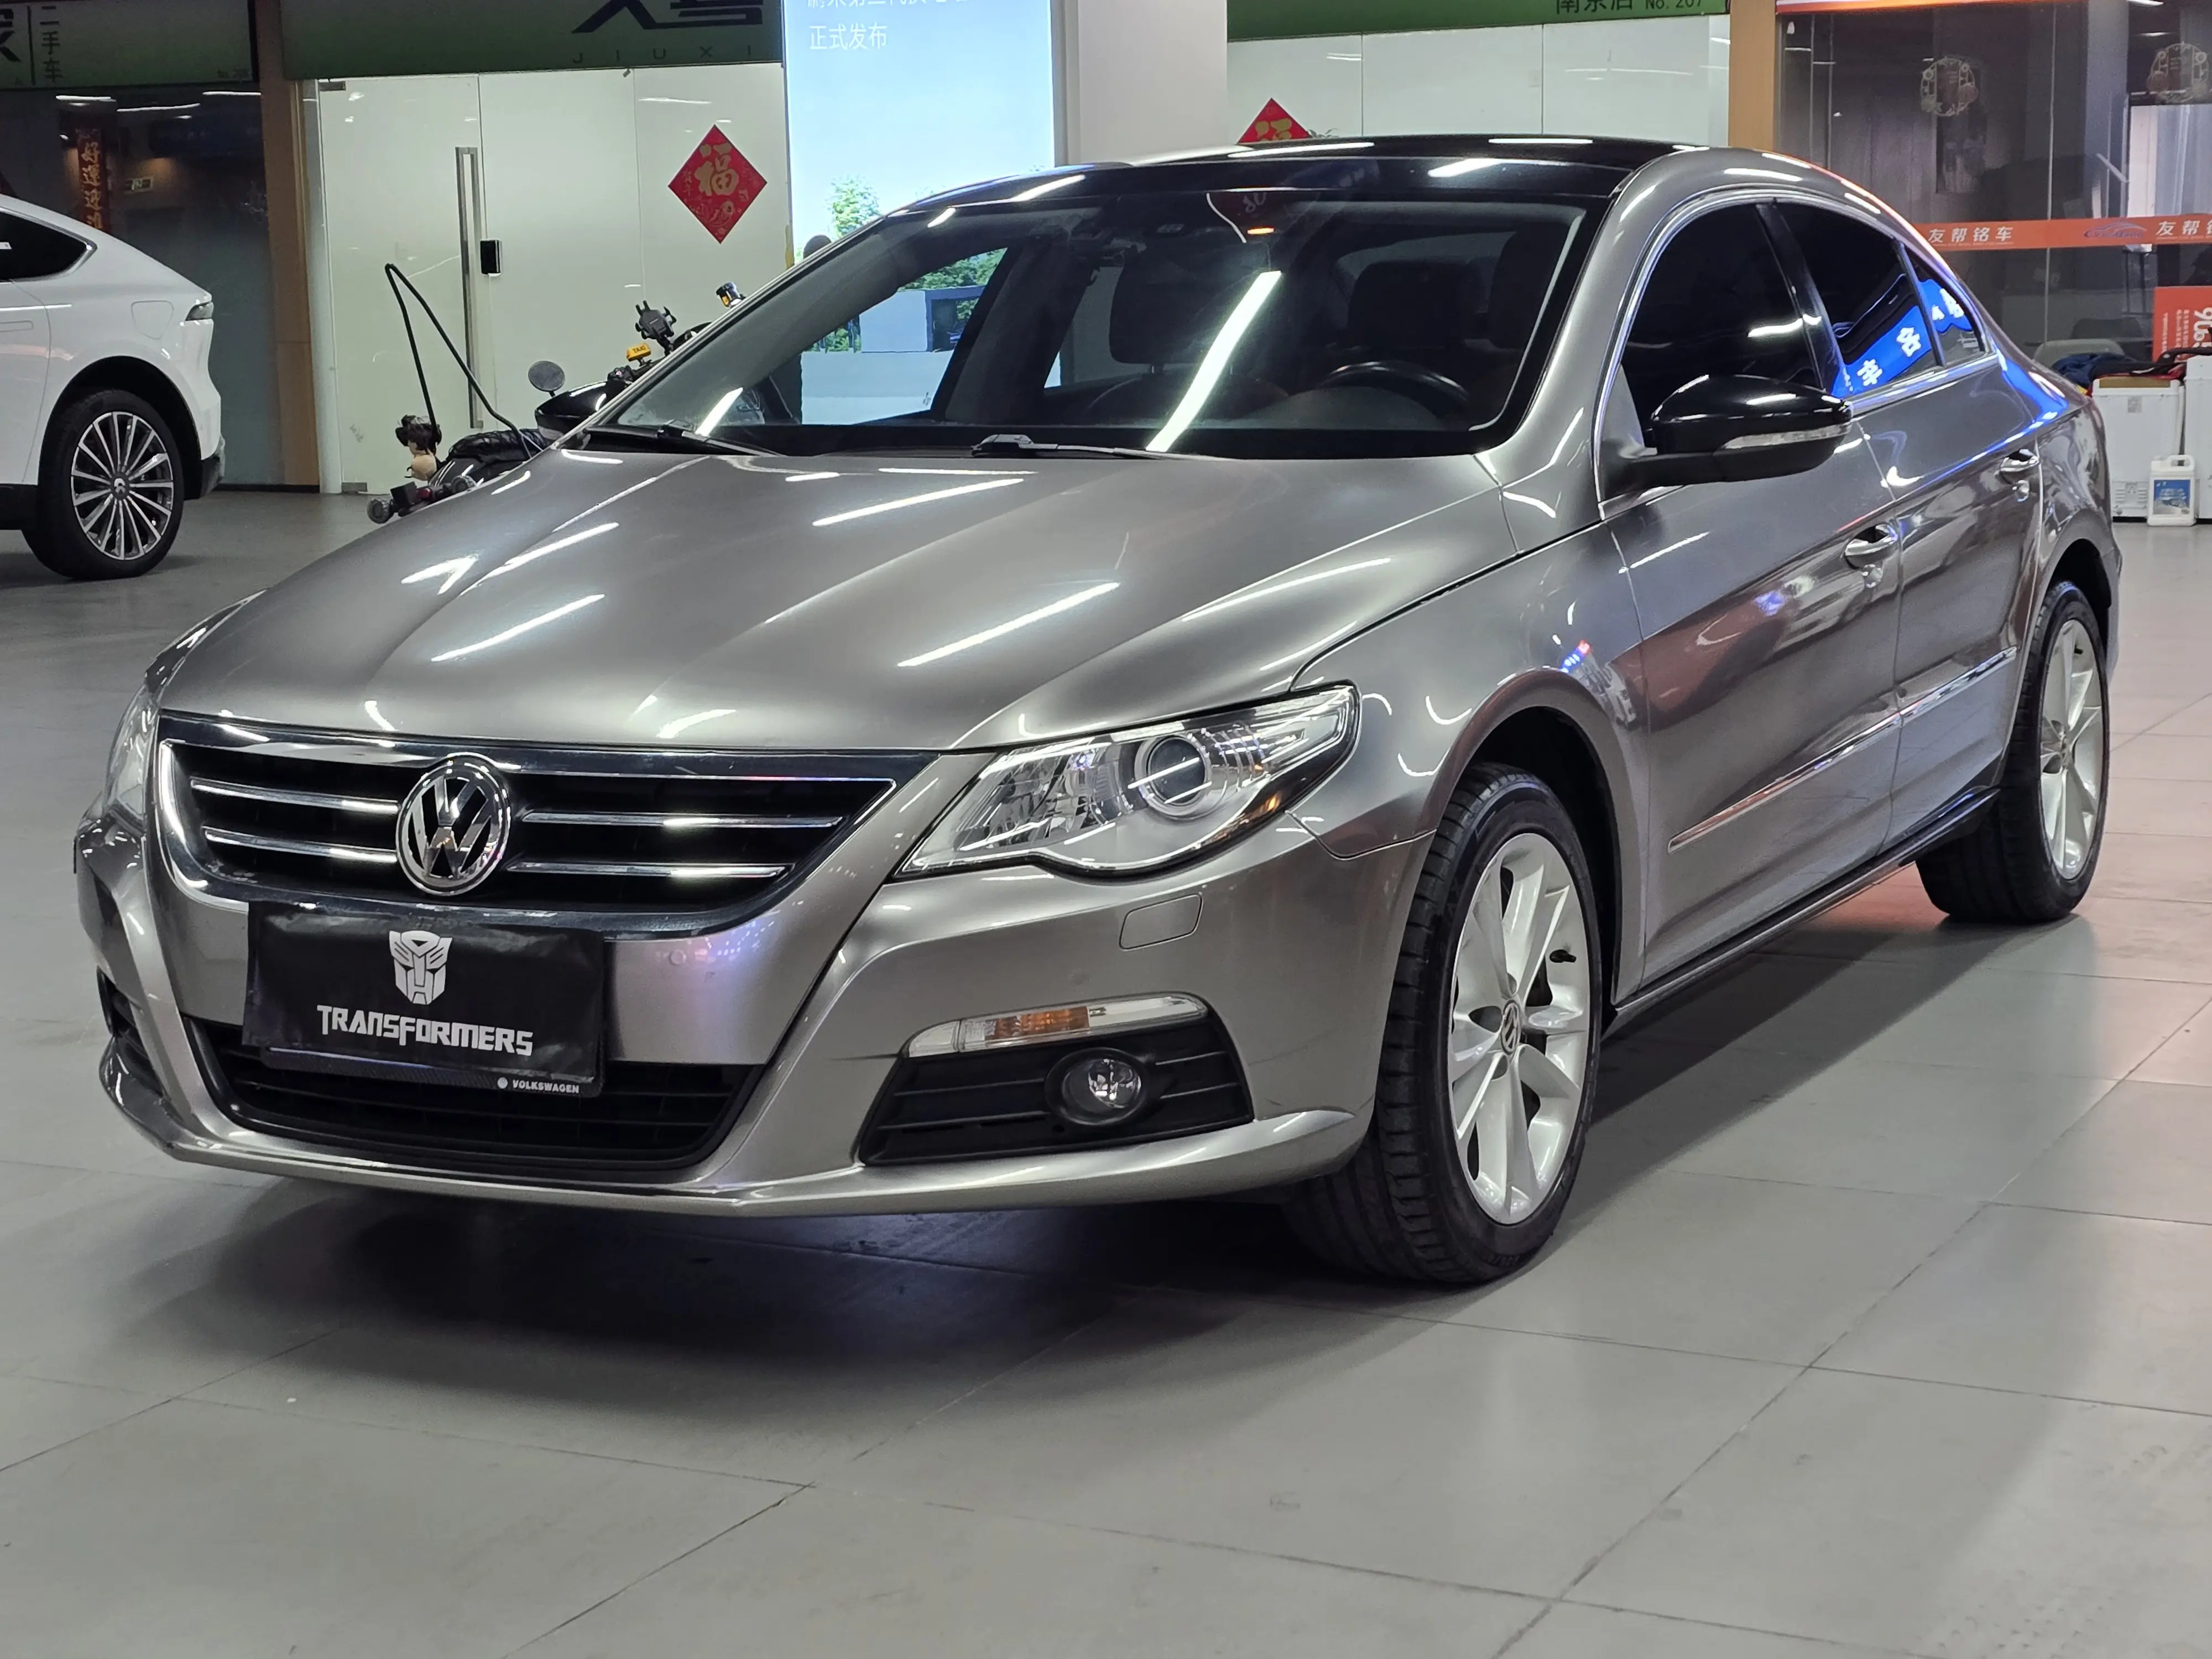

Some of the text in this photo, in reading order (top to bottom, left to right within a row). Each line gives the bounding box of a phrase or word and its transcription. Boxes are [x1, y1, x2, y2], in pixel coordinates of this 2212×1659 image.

[40, 6, 64, 84] 二手车
[809, 22, 888, 50] 正式发布
[694, 143, 739, 196] 福
[1928, 226, 2013, 243] 友帮铭车
[632, 345, 646, 353] TAXI
[317, 1005, 533, 1056] TRANSFORMERS
[513, 1079, 579, 1094] VOLKSWAGEN
